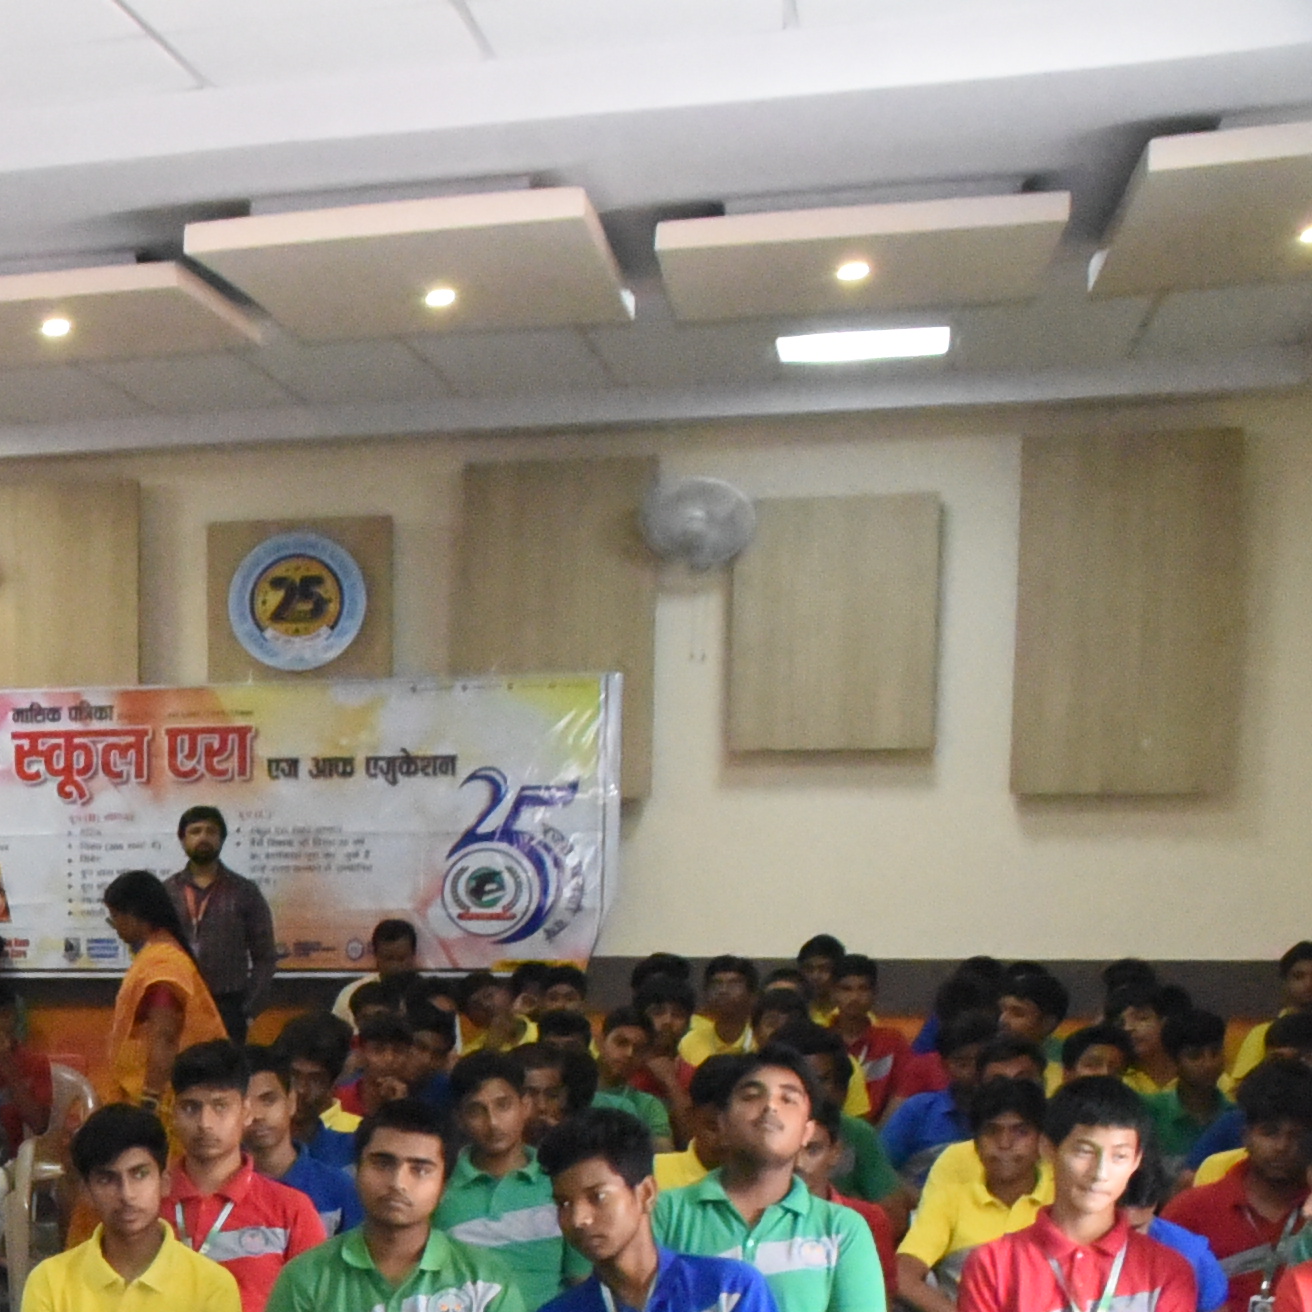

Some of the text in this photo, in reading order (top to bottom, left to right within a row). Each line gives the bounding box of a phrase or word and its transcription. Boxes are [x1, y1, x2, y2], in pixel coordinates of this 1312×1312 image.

[269, 575, 326, 622] 25
[11, 725, 253, 802] स्कूल एरा
[267, 756, 300, 781] एज
[365, 748, 457, 786] एजुकेशन
